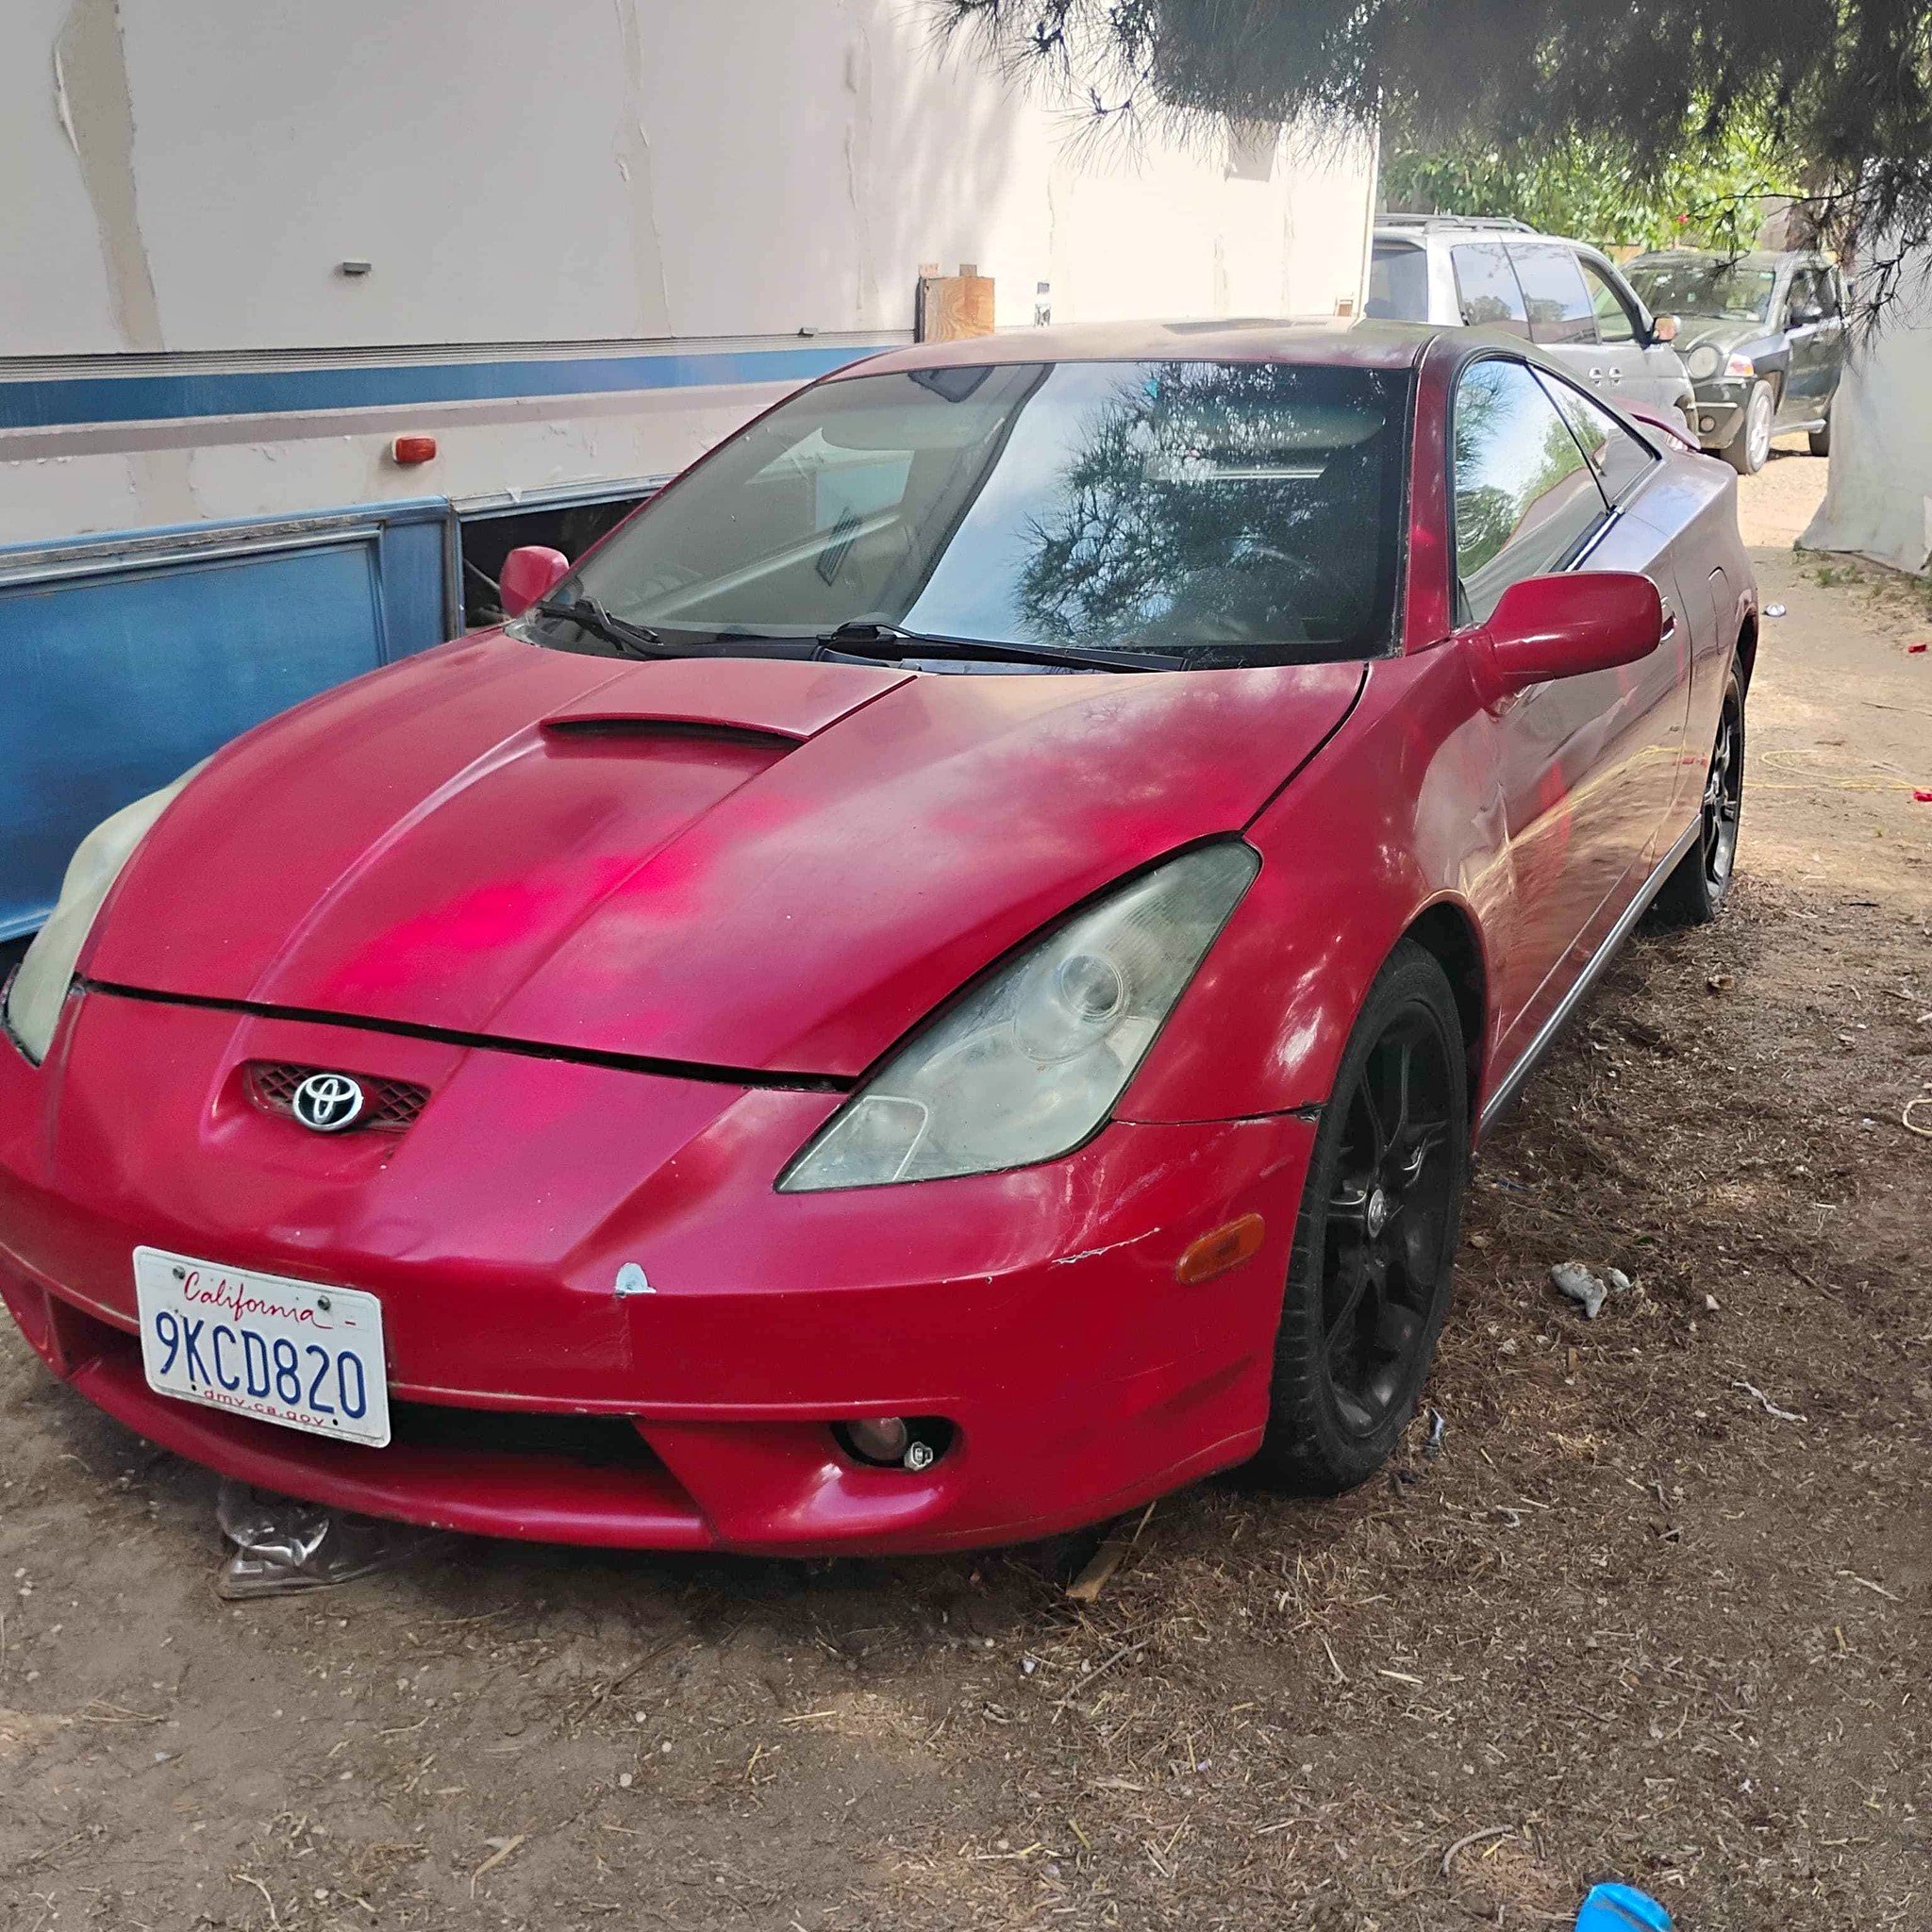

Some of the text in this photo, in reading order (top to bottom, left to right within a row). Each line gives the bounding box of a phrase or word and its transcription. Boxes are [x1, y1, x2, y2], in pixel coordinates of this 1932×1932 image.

[184, 1272, 333, 1329] California
[156, 1311, 367, 1419] 9KCD820
[204, 1391, 325, 1426] dmv.ca.gov
